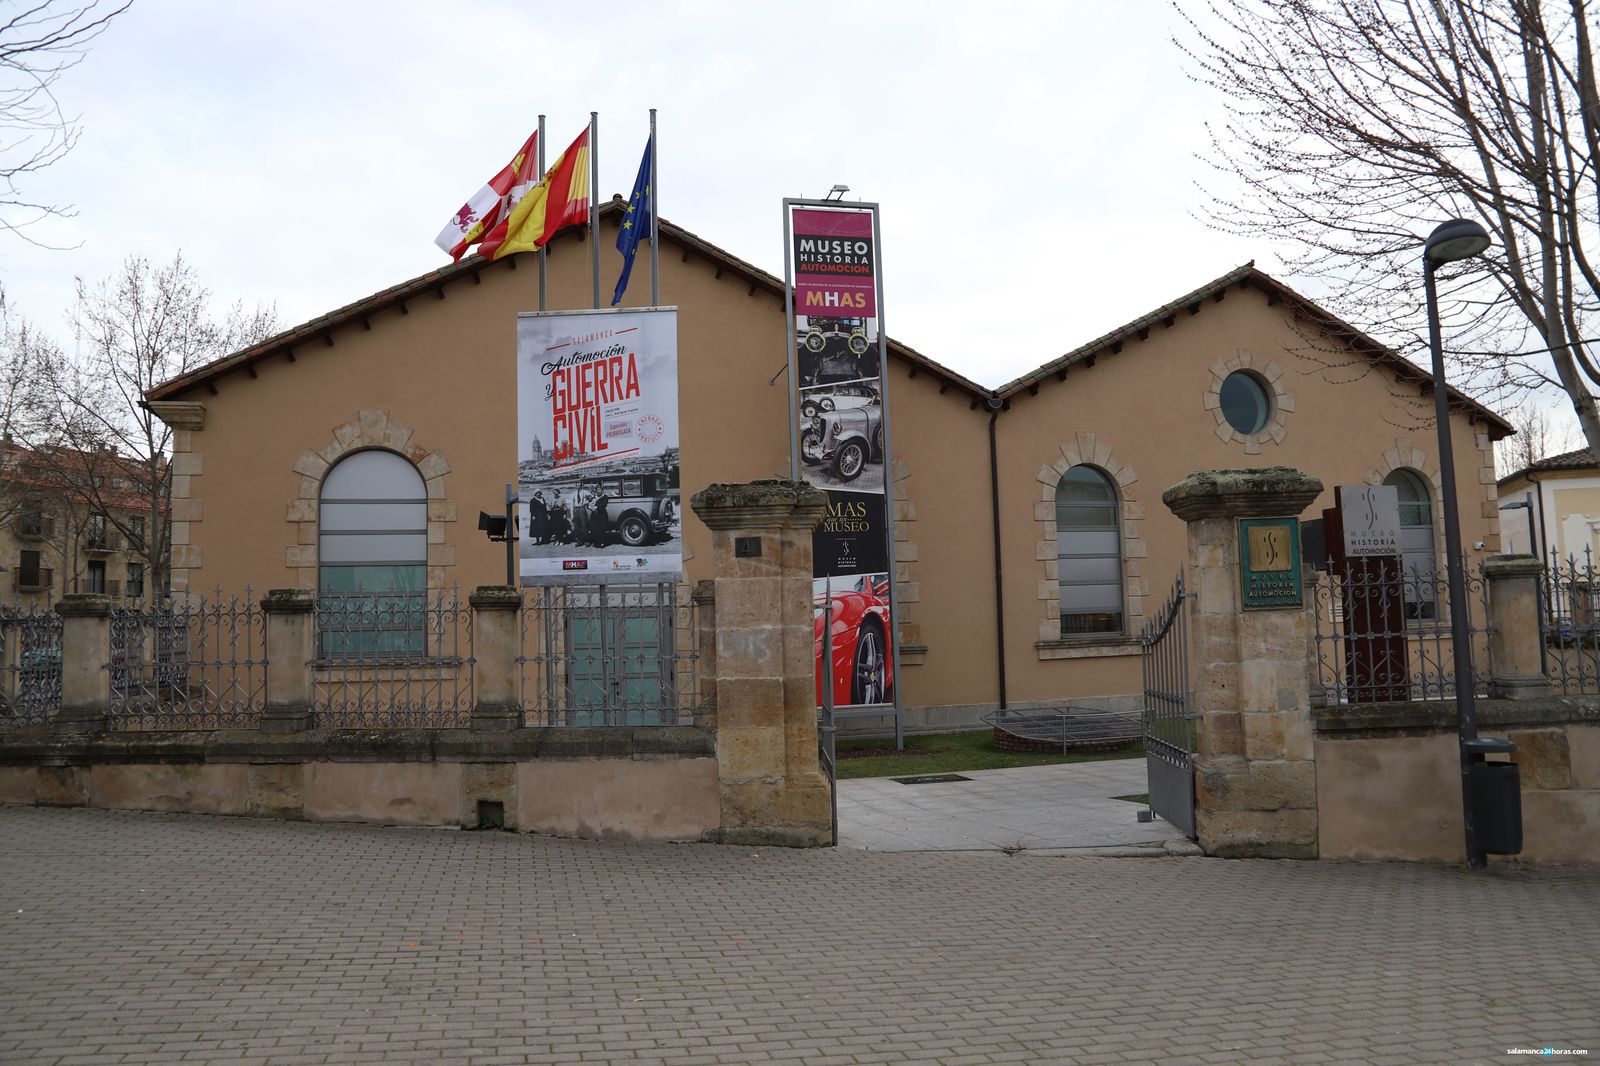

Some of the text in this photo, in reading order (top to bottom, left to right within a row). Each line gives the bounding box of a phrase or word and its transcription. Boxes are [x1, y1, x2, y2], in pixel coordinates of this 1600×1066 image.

[800, 239, 868, 255] MUSEO
[800, 254, 869, 264] HISTORIA
[805, 290, 866, 308] MHAS
[541, 343, 627, 376] Automoción
[552, 353, 640, 416] GUERRA
[553, 405, 608, 461] CIVIL
[827, 502, 866, 517] MAS
[823, 521, 870, 533] MUSEO
